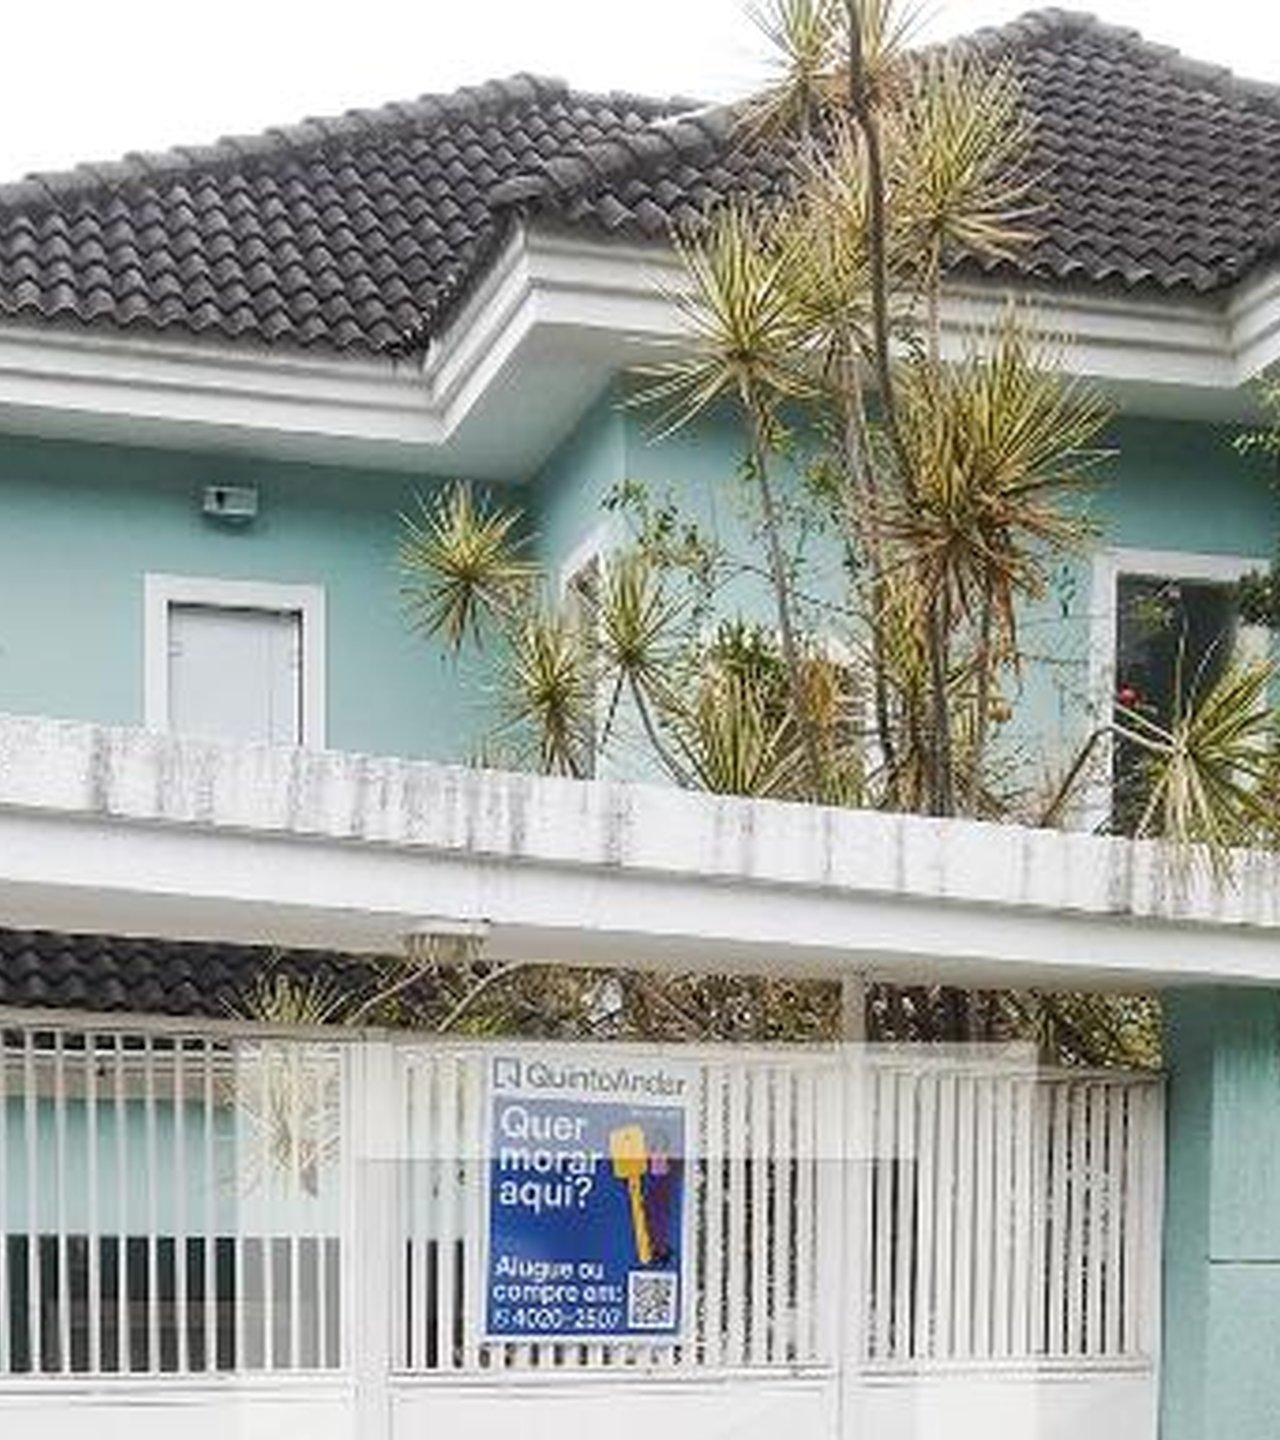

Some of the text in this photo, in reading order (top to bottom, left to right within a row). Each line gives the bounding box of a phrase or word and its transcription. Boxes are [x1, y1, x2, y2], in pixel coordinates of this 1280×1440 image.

[501, 1104, 588, 1140] Quer
[500, 1147, 604, 1175] morar
[500, 1176, 593, 1215] aqui?
[495, 1254, 605, 1283] Alugue ou
[492, 1284, 623, 1305] compre em:
